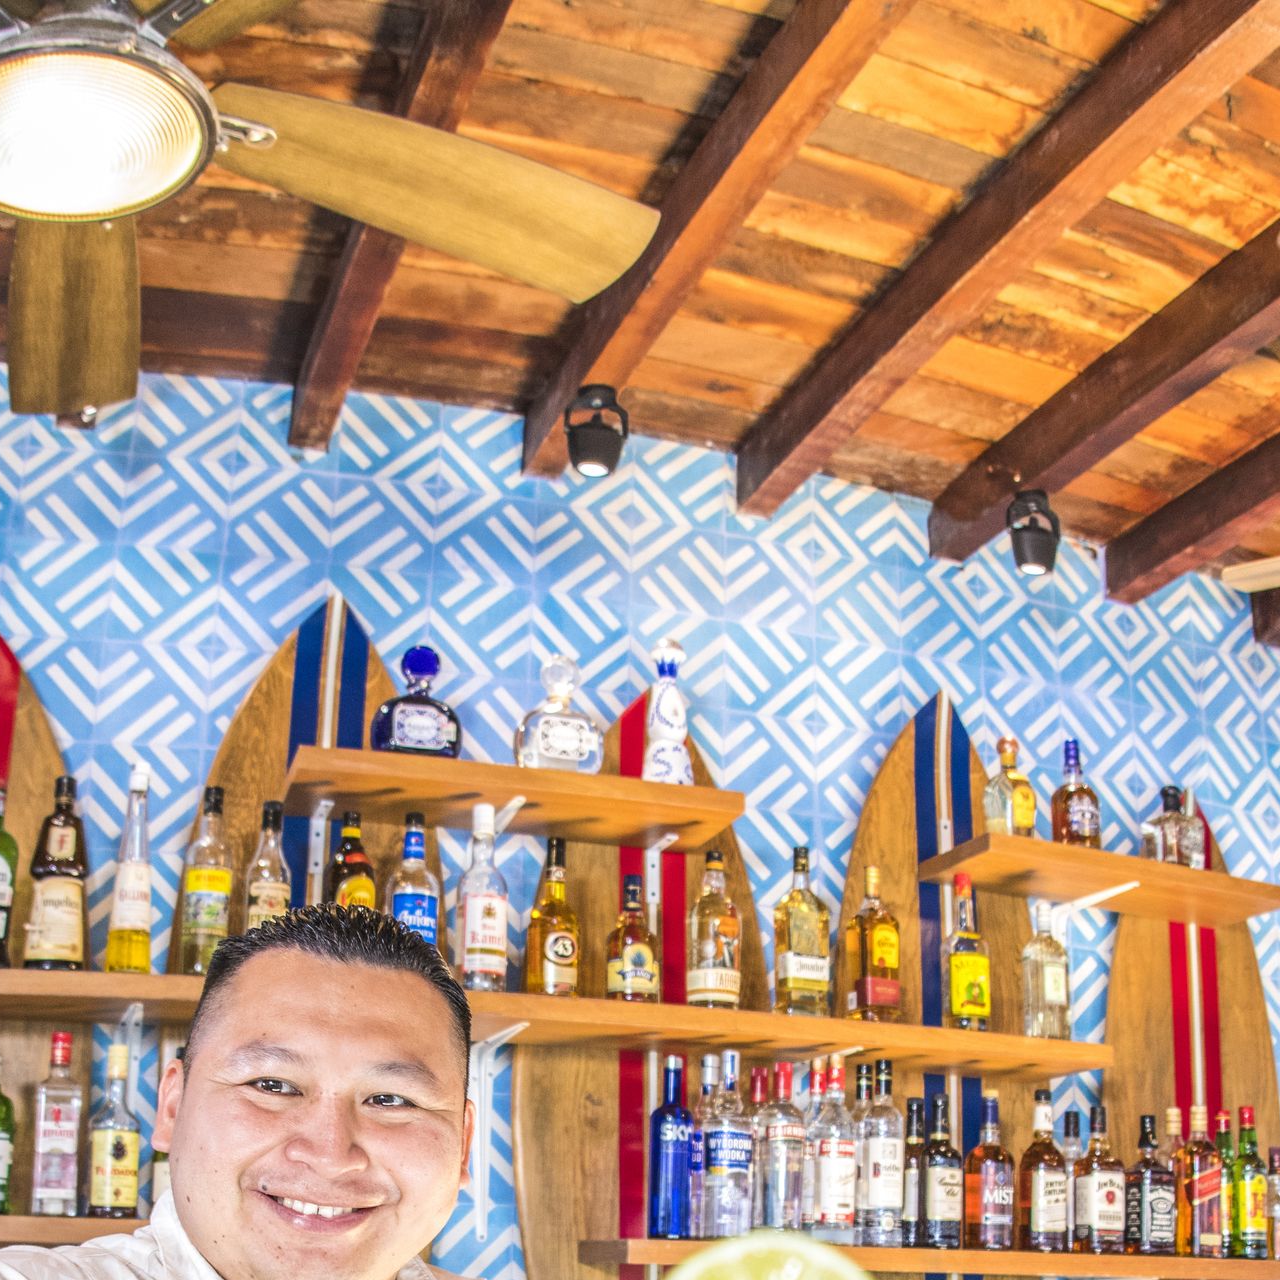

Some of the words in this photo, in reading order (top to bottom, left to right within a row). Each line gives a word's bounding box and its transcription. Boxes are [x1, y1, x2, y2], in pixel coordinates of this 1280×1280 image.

[555, 937, 574, 958] 43
[719, 1150, 746, 1161] WODKA
[983, 1187, 1014, 1205] MIST
